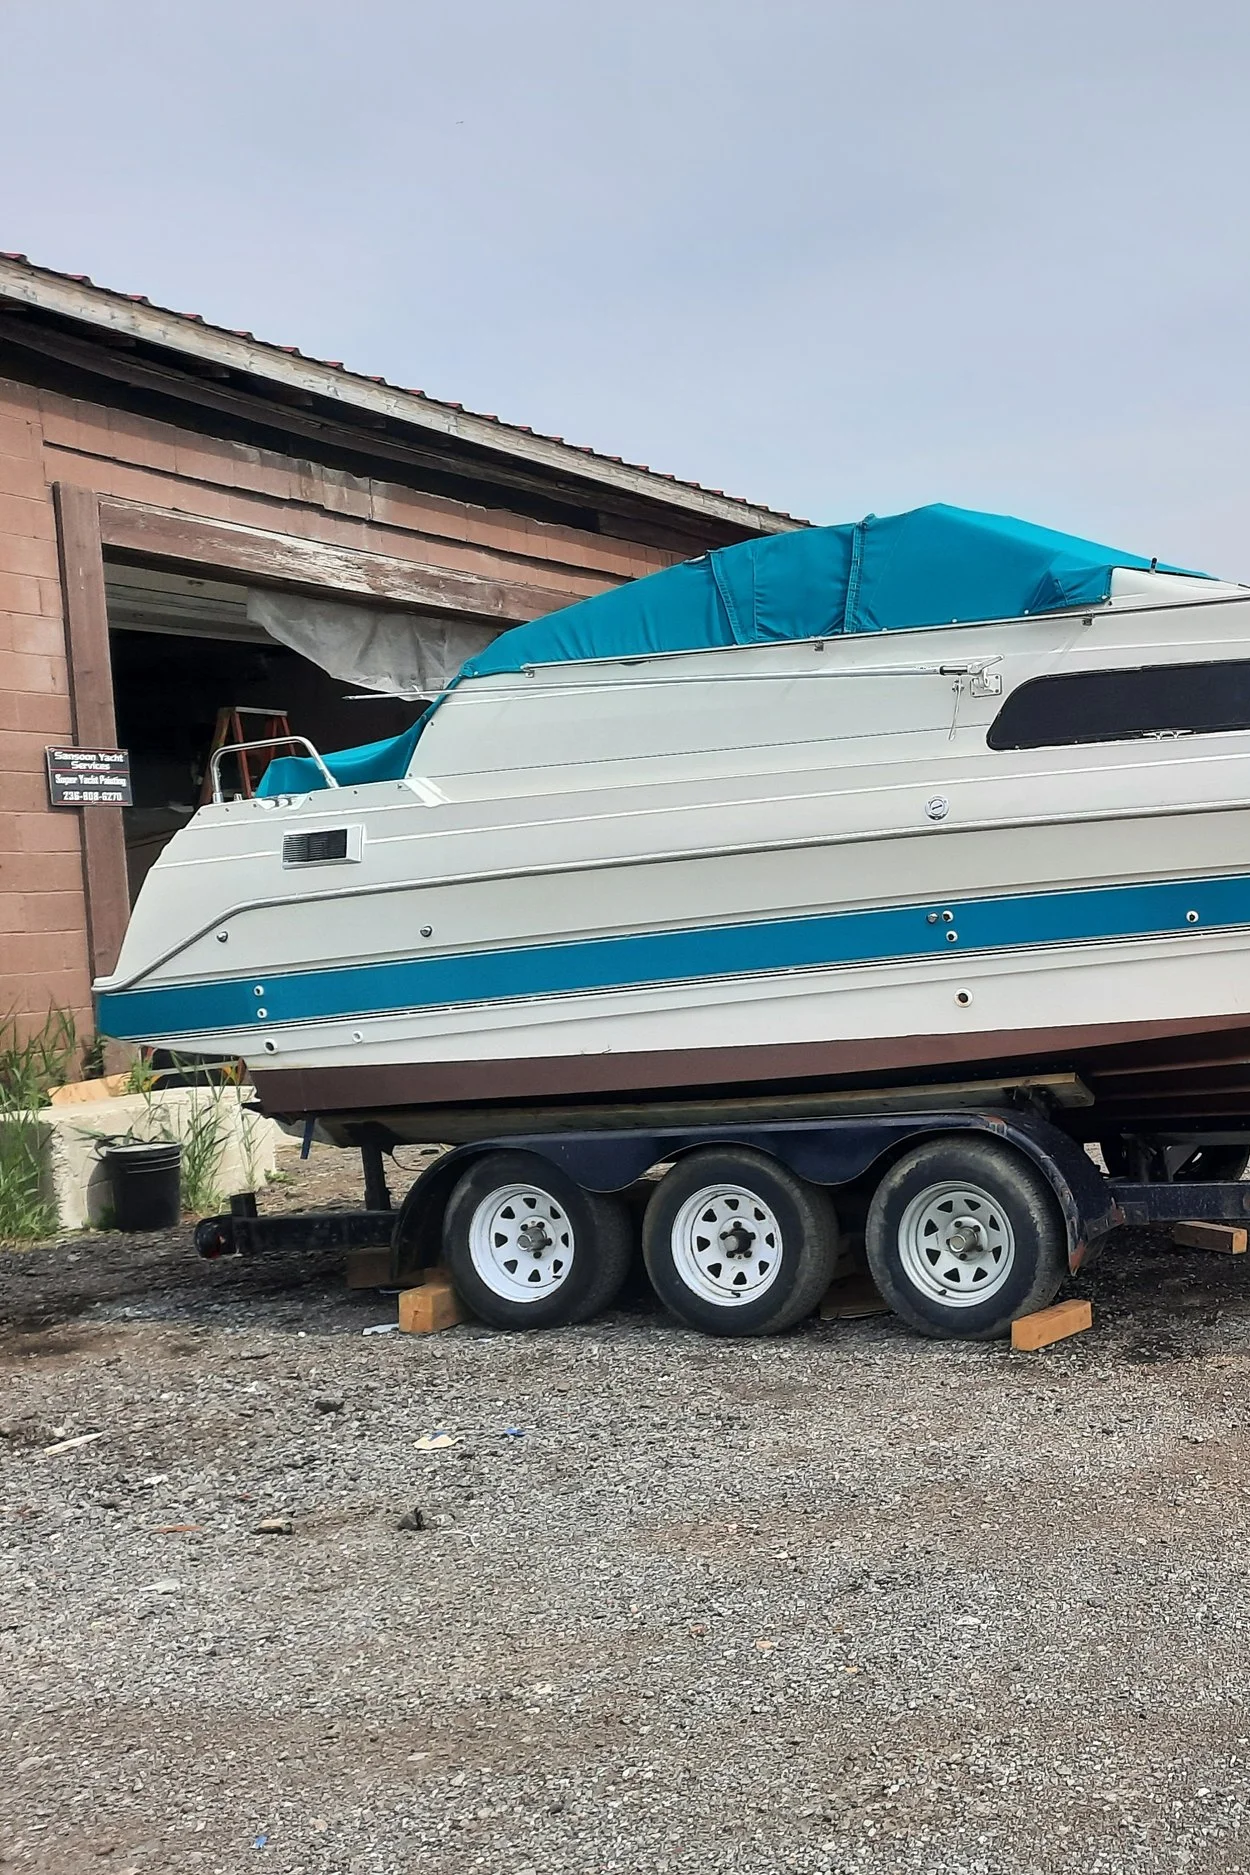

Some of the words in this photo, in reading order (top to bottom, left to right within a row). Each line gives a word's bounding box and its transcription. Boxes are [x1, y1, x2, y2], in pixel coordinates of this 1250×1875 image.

[98, 753, 124, 762] Yacht
[71, 761, 110, 770] Services
[55, 773, 78, 786] Super
[78, 774, 99, 785] Yacht
[99, 775, 127, 787] Painting
